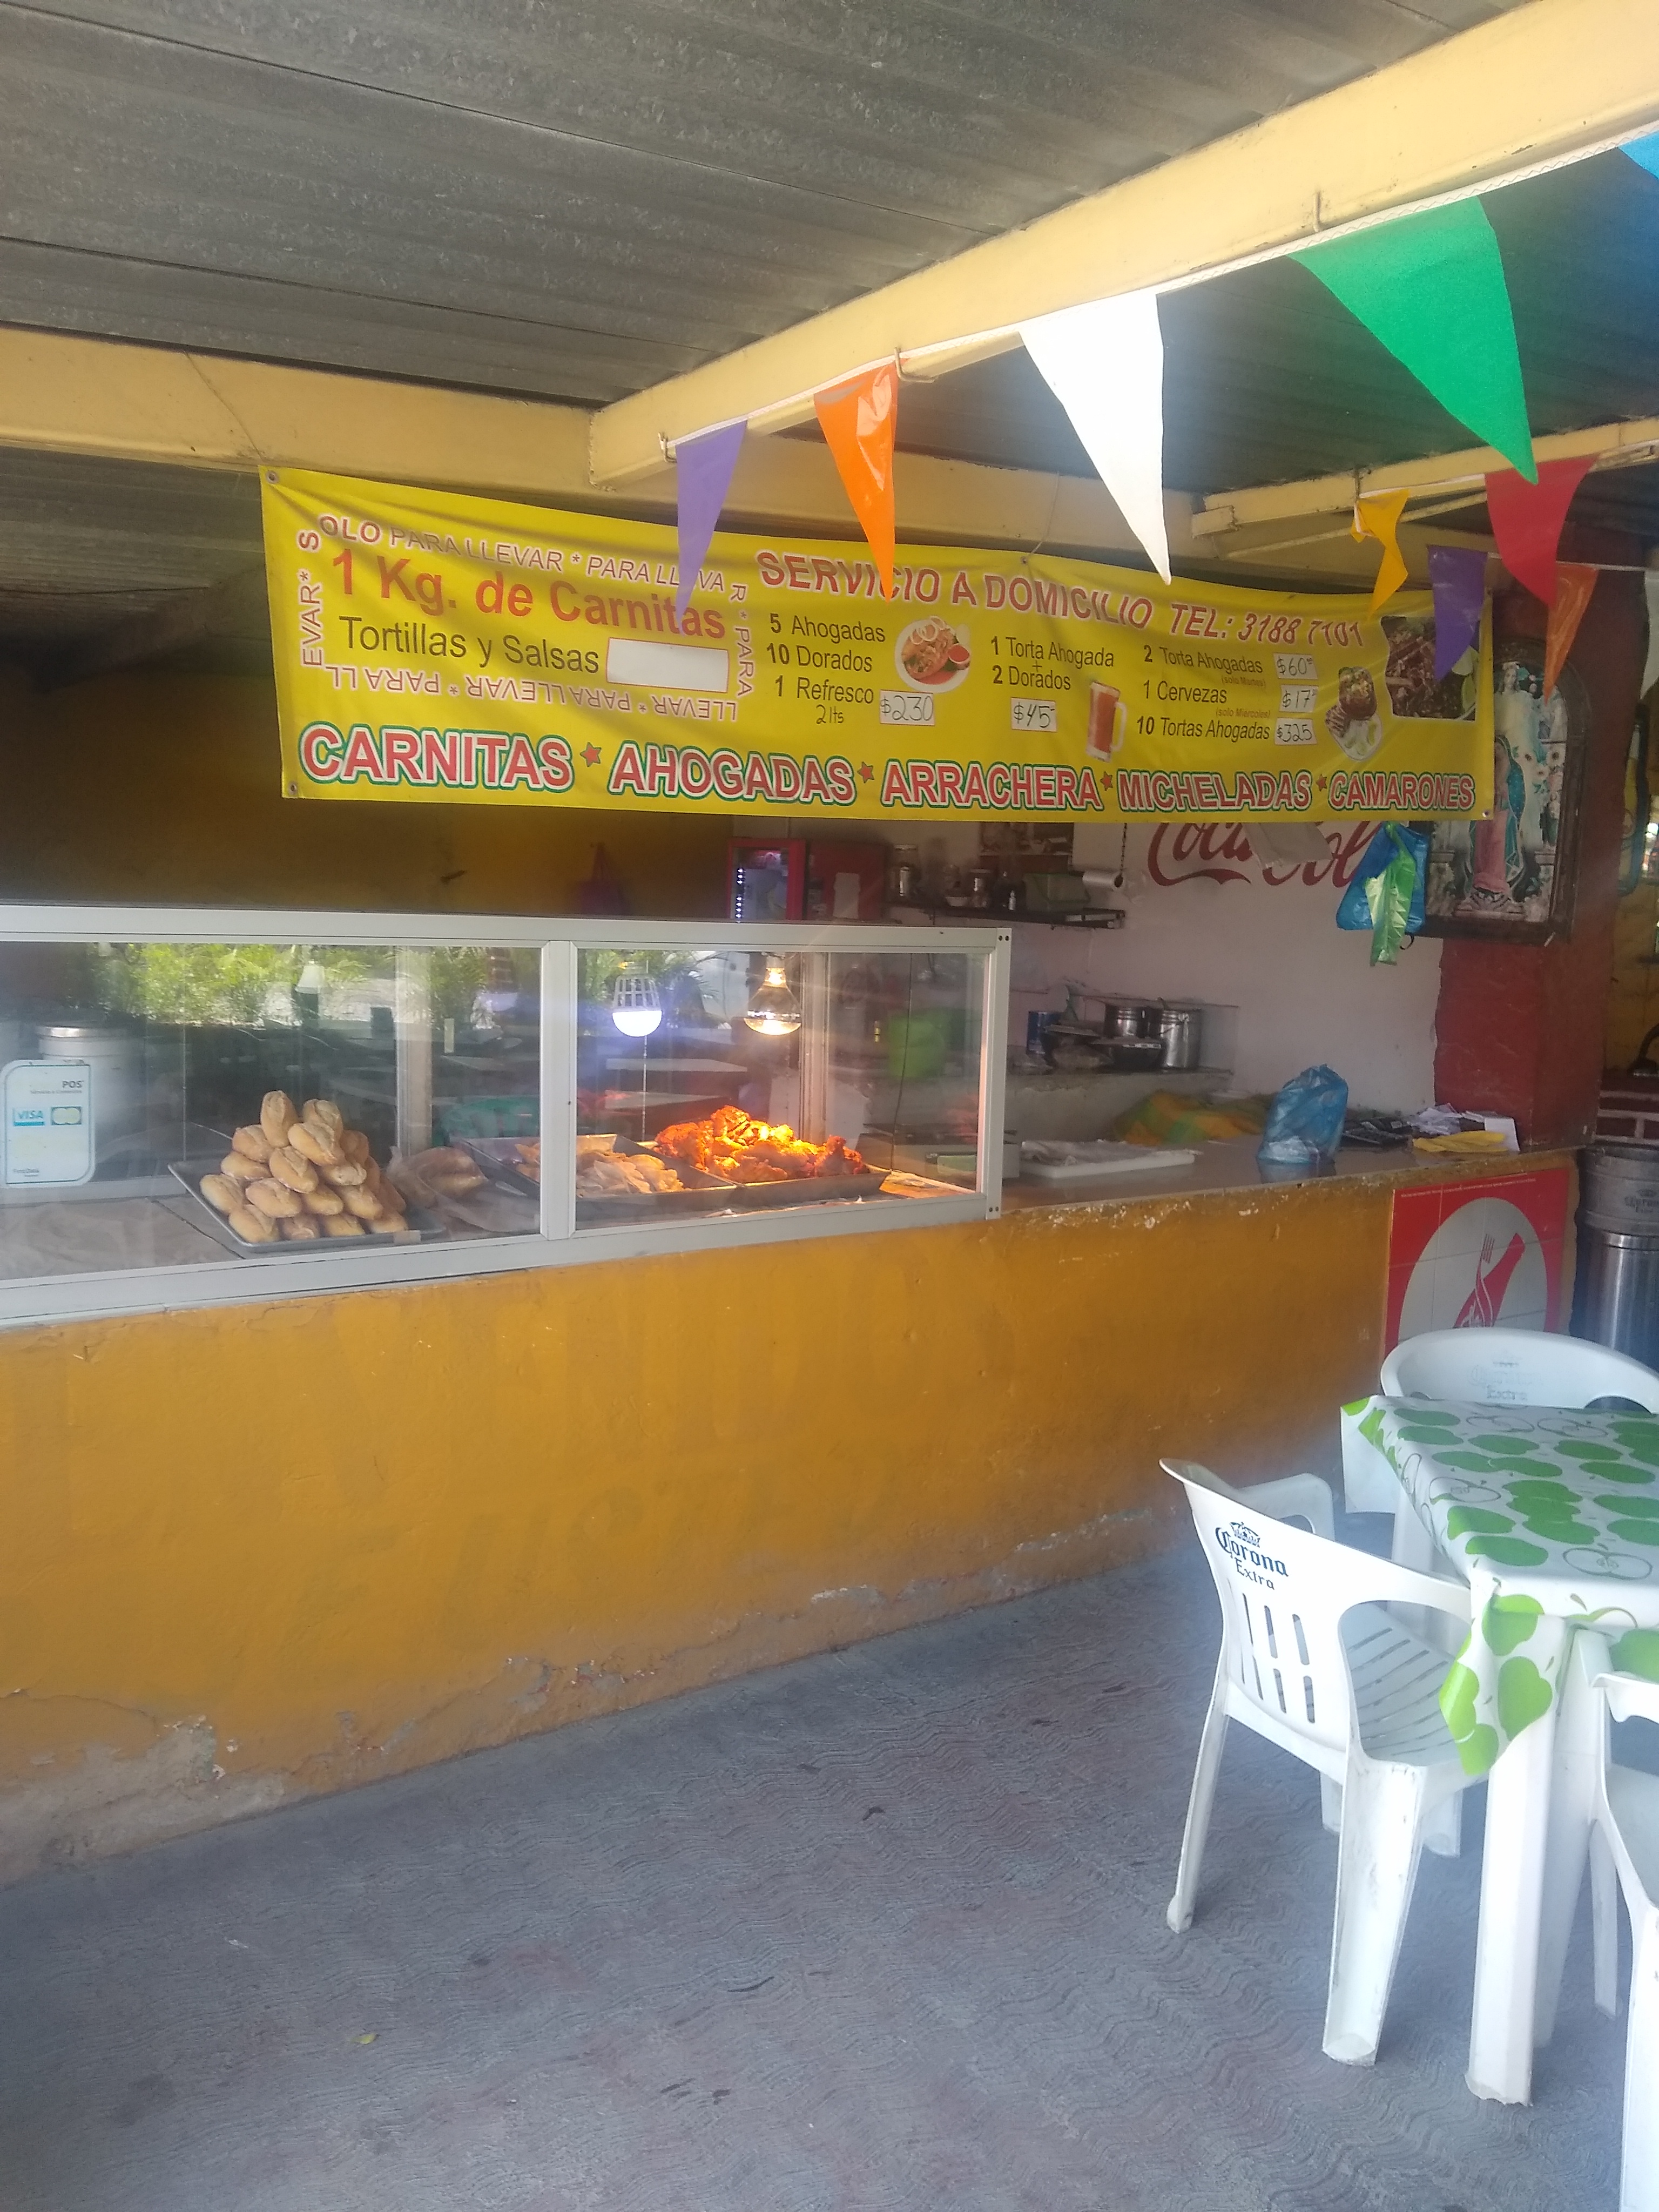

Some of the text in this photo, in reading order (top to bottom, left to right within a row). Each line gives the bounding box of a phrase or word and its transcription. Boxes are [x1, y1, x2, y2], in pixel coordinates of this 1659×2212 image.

[656, 565, 724, 591] LLVA
[333, 549, 726, 639] 1 Kg. de Carnitas
[952, 571, 976, 606] A
[984, 574, 1153, 630] DOMICILIO
[1171, 603, 1233, 638] TEL:
[1237, 612, 1302, 644] 3188
[1308, 620, 1364, 647] 7101
[770, 612, 886, 644] 5 Ahogadas
[339, 615, 599, 673] Tortillas y Salsas
[766, 643, 873, 673] 10 Dorados
[991, 635, 1114, 670] 1 Torta Ahogada
[1143, 644, 1263, 675] 2 Torta Ahogadas
[775, 675, 874, 704] 1 Refresco
[992, 664, 1071, 691] 2 Dorados
[1143, 679, 1228, 704] 1 Cervezas
[880, 694, 934, 722] $230
[1136, 716, 1270, 743] 10 Tortas Ahogadas
[1276, 724, 1313, 743] $325
[299, 721, 1476, 813] CARNITAS AHOGADAS ARRACHERA MICHELADAS CAMARONES
[17, 1110, 43, 1119] VISA
[1215, 1526, 1290, 1577] Corona
[1234, 1556, 1275, 1590] Extra
